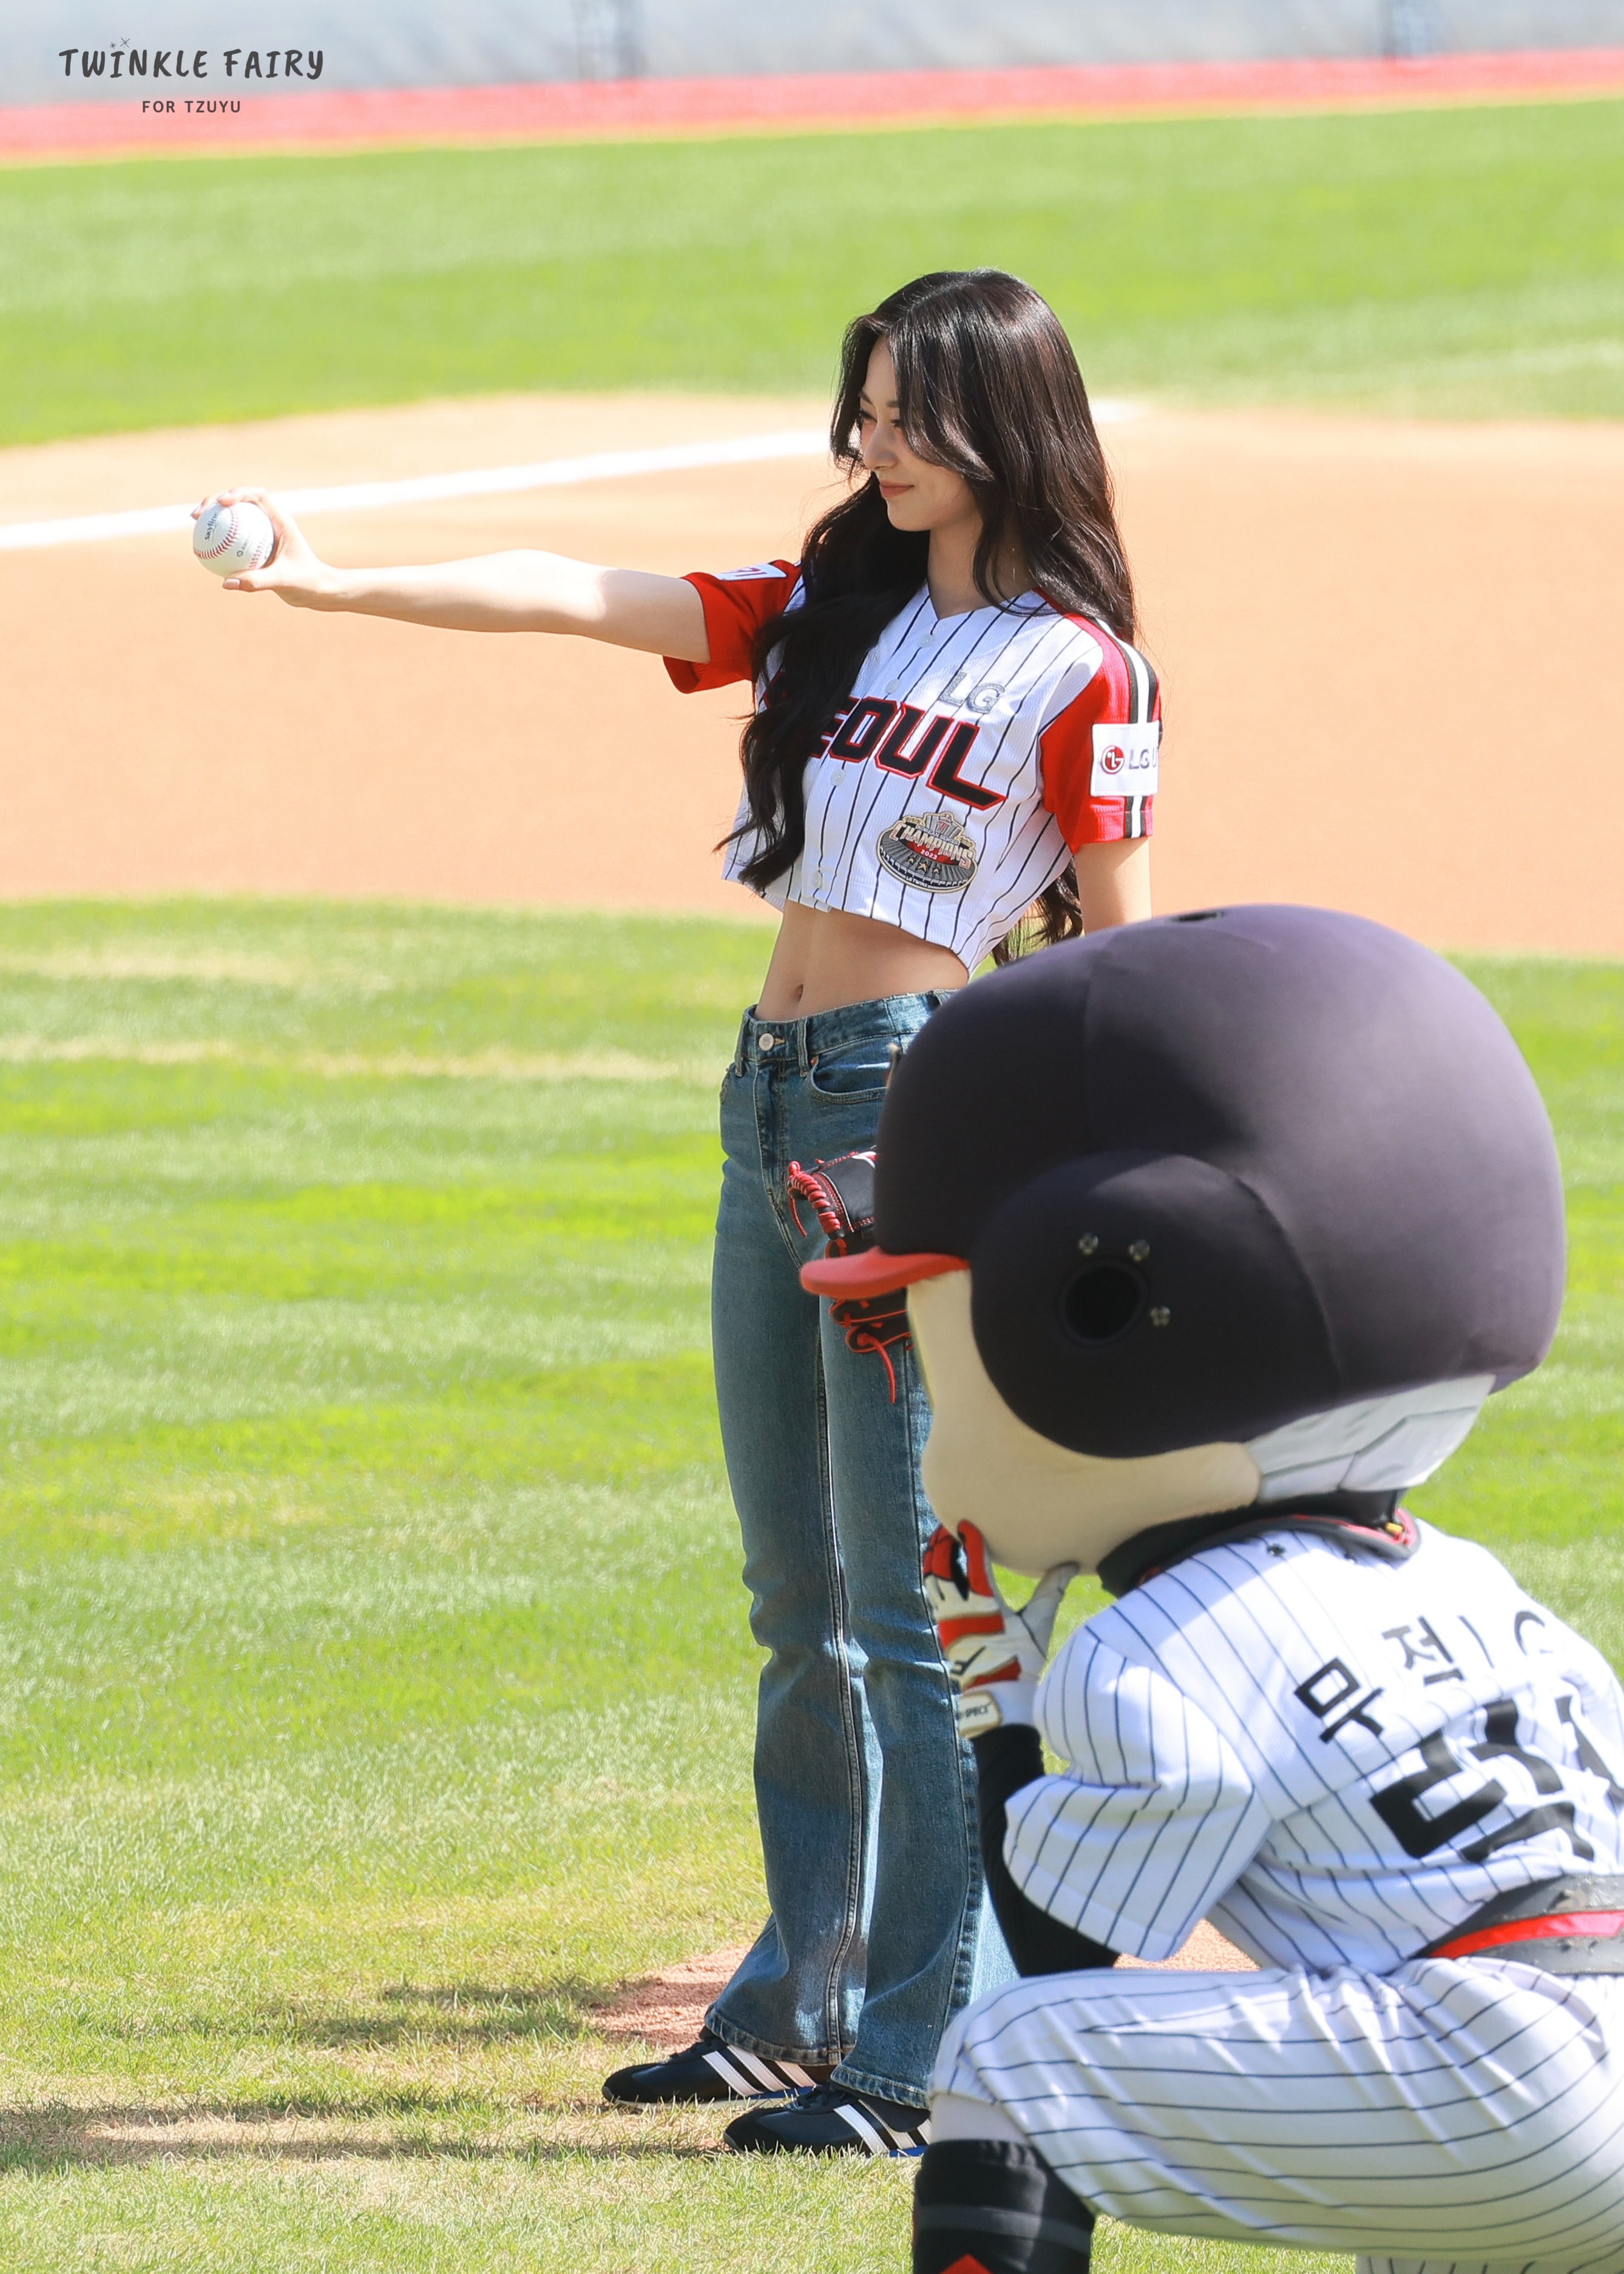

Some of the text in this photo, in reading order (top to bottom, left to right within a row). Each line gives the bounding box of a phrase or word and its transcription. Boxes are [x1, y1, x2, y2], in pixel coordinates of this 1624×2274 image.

[939, 670, 1006, 714] LG
[1128, 748, 1150, 770] LG
[888, 821, 974, 871] CHAMPIONS
[920, 849, 938, 860] 2023
